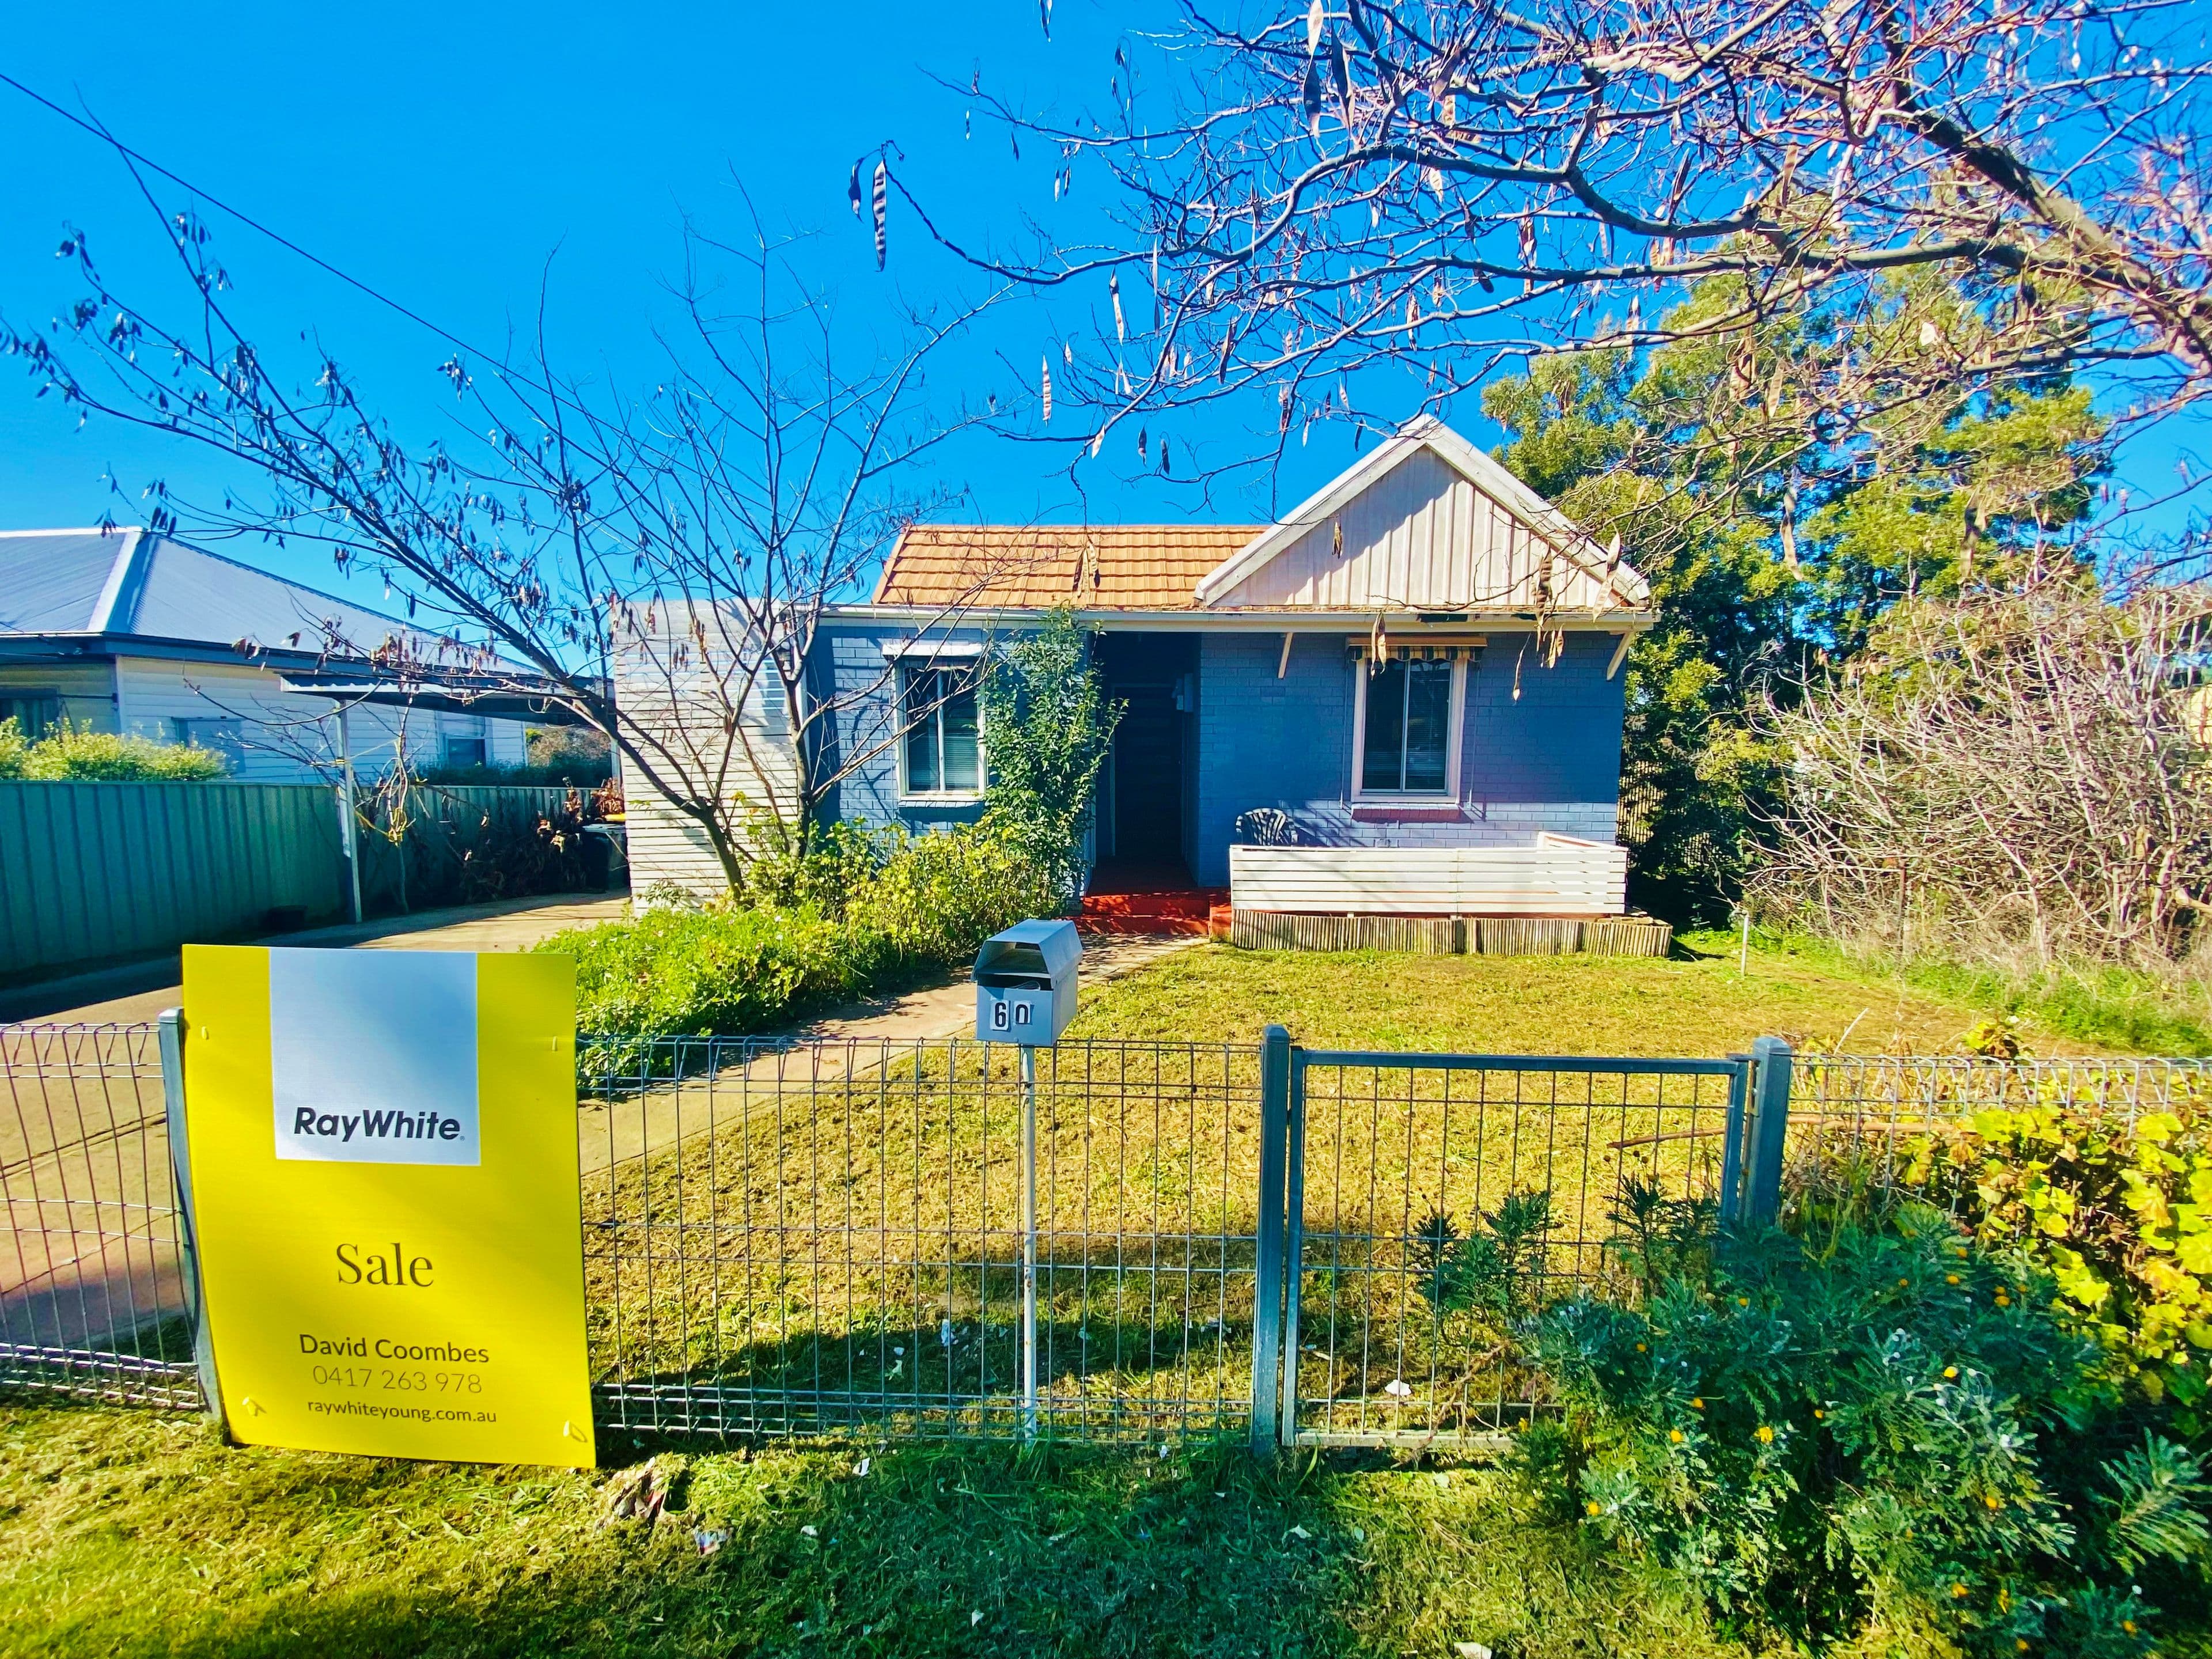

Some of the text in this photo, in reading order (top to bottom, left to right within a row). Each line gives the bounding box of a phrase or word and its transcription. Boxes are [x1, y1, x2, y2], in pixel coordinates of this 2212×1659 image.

[336, 1243, 433, 1287] Sale
[300, 1334, 489, 1362] David Coombes
[313, 1365, 482, 1393] 0417 263 978
[308, 1401, 497, 1422] raywhiteyoung.com.au
